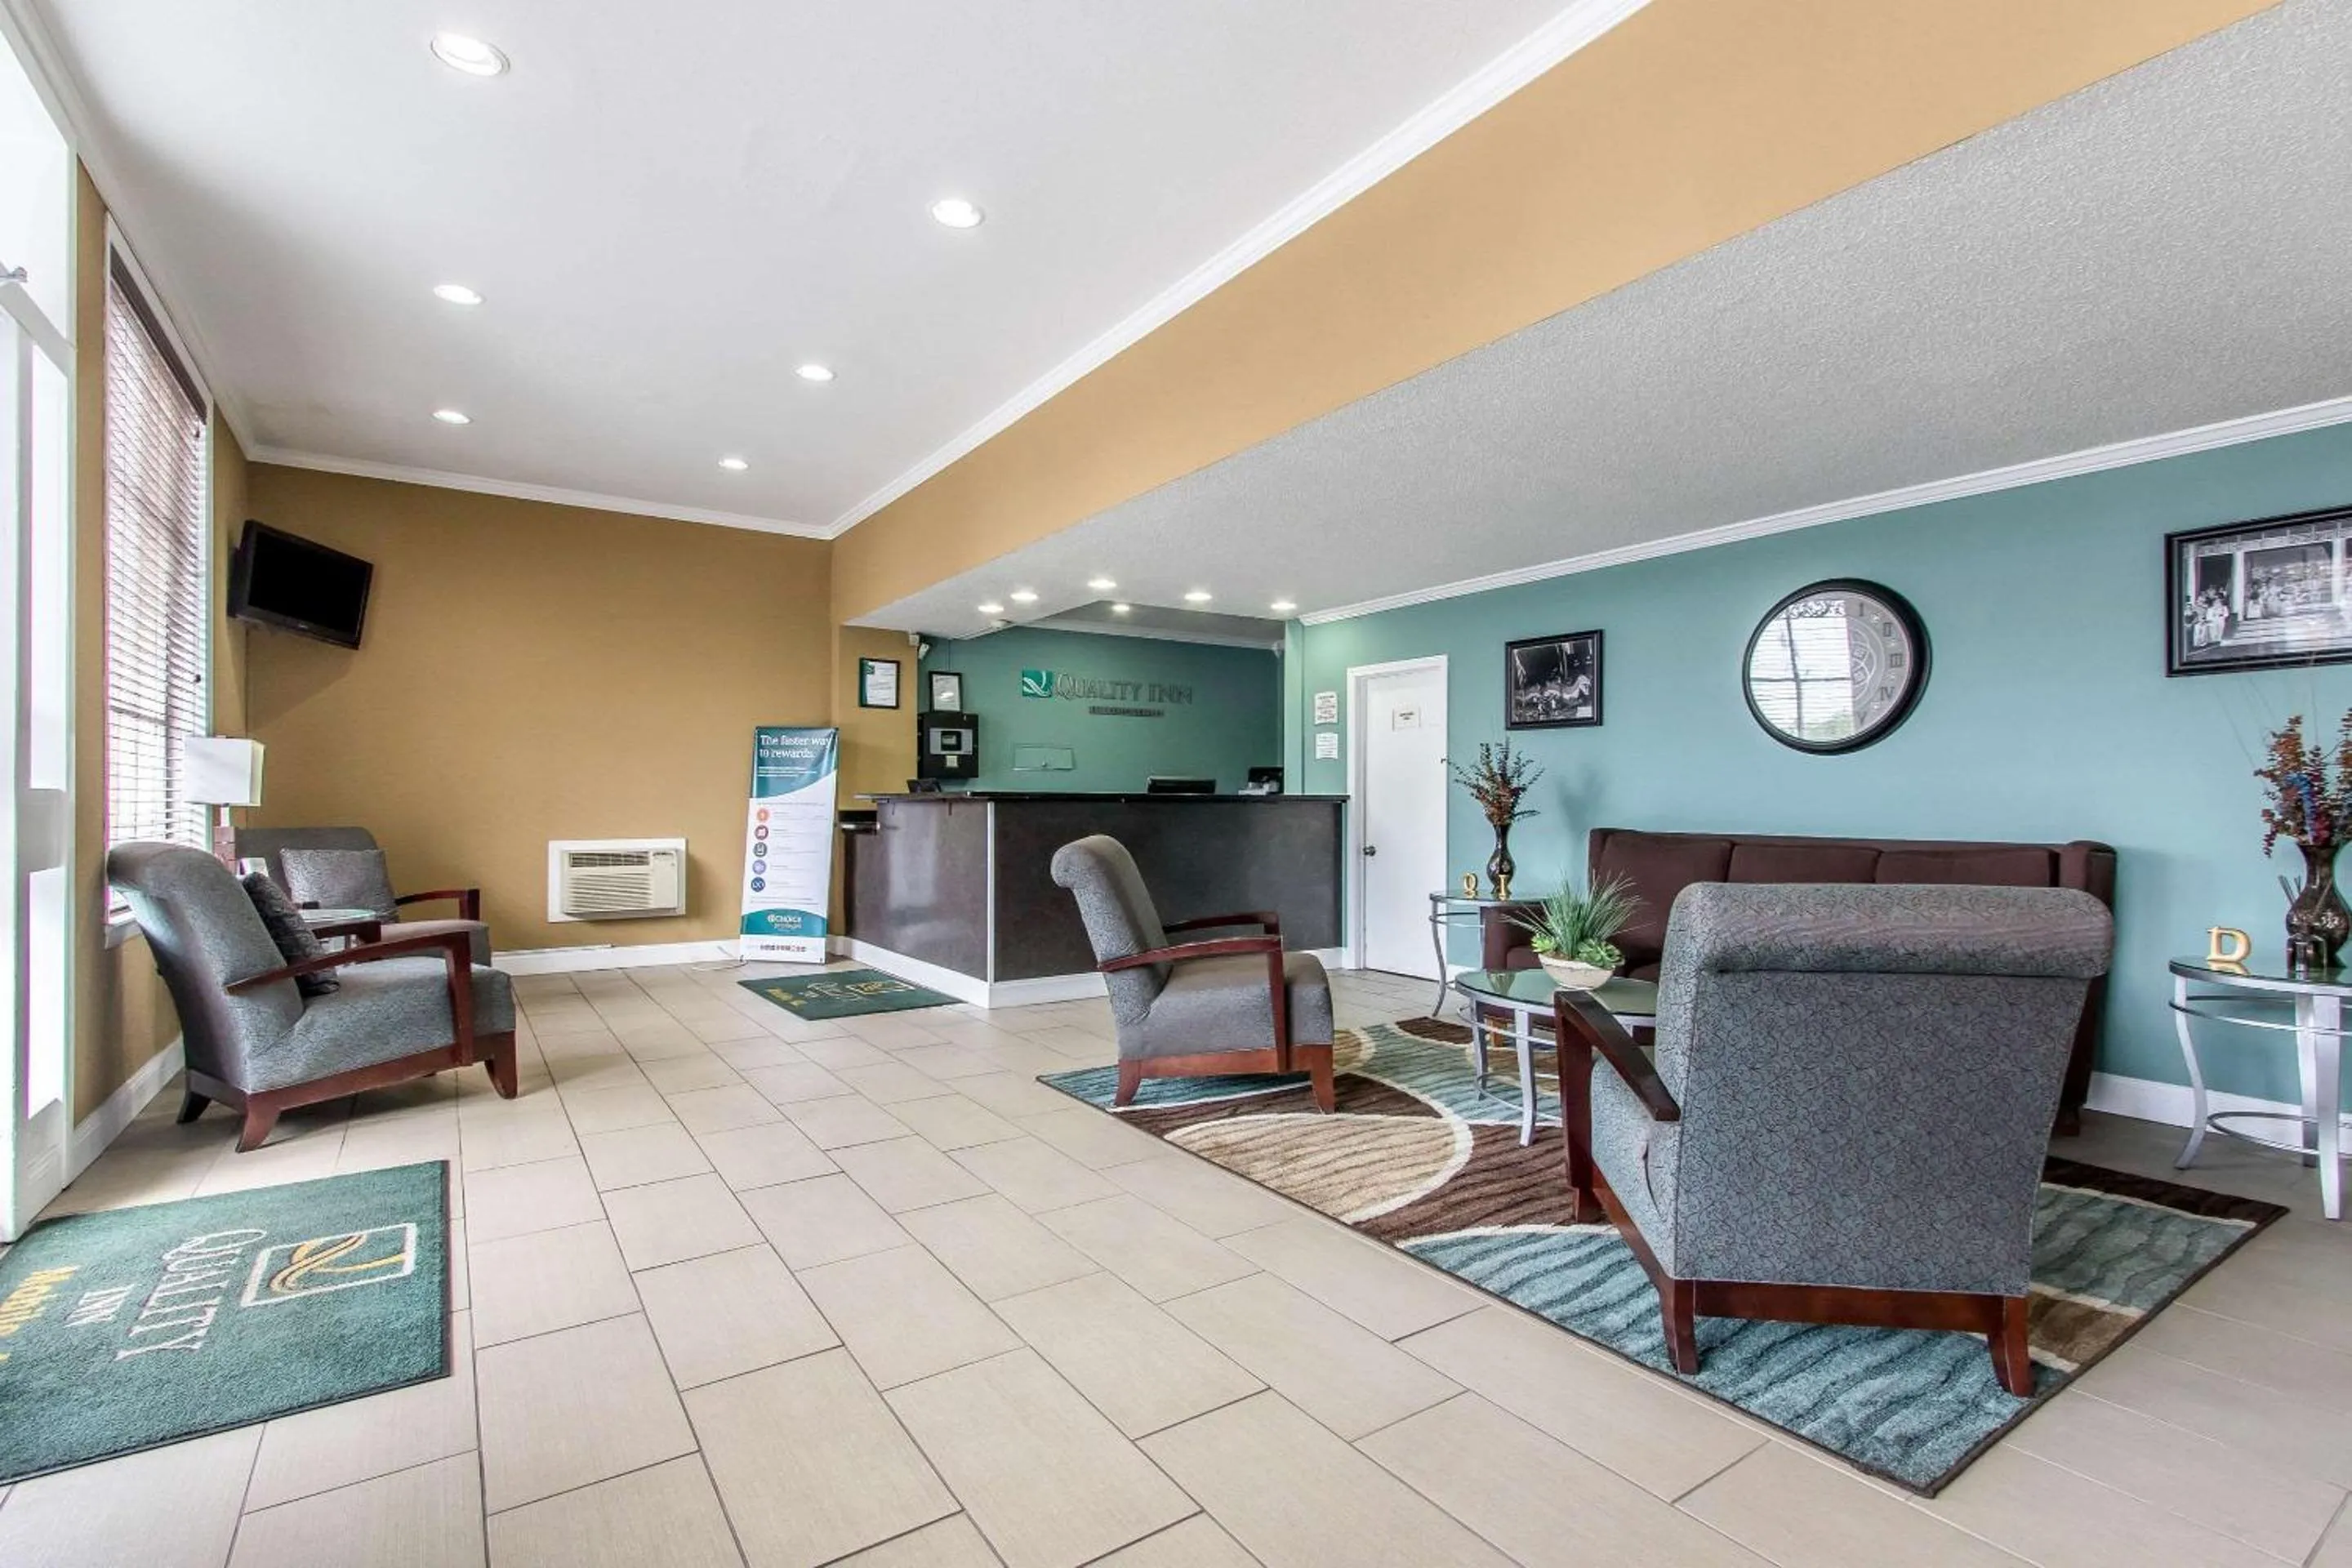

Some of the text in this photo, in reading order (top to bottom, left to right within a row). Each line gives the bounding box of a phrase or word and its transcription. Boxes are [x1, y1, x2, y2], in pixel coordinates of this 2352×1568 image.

[1057, 672, 1193, 704] QUALITY INN
[760, 735, 778, 746] The
[811, 737, 831, 747] way
[760, 749, 769, 758] to
[2207, 926, 2252, 961] D
[62, 1283, 136, 1329] INN
[113, 1228, 267, 1361] QUALITY
